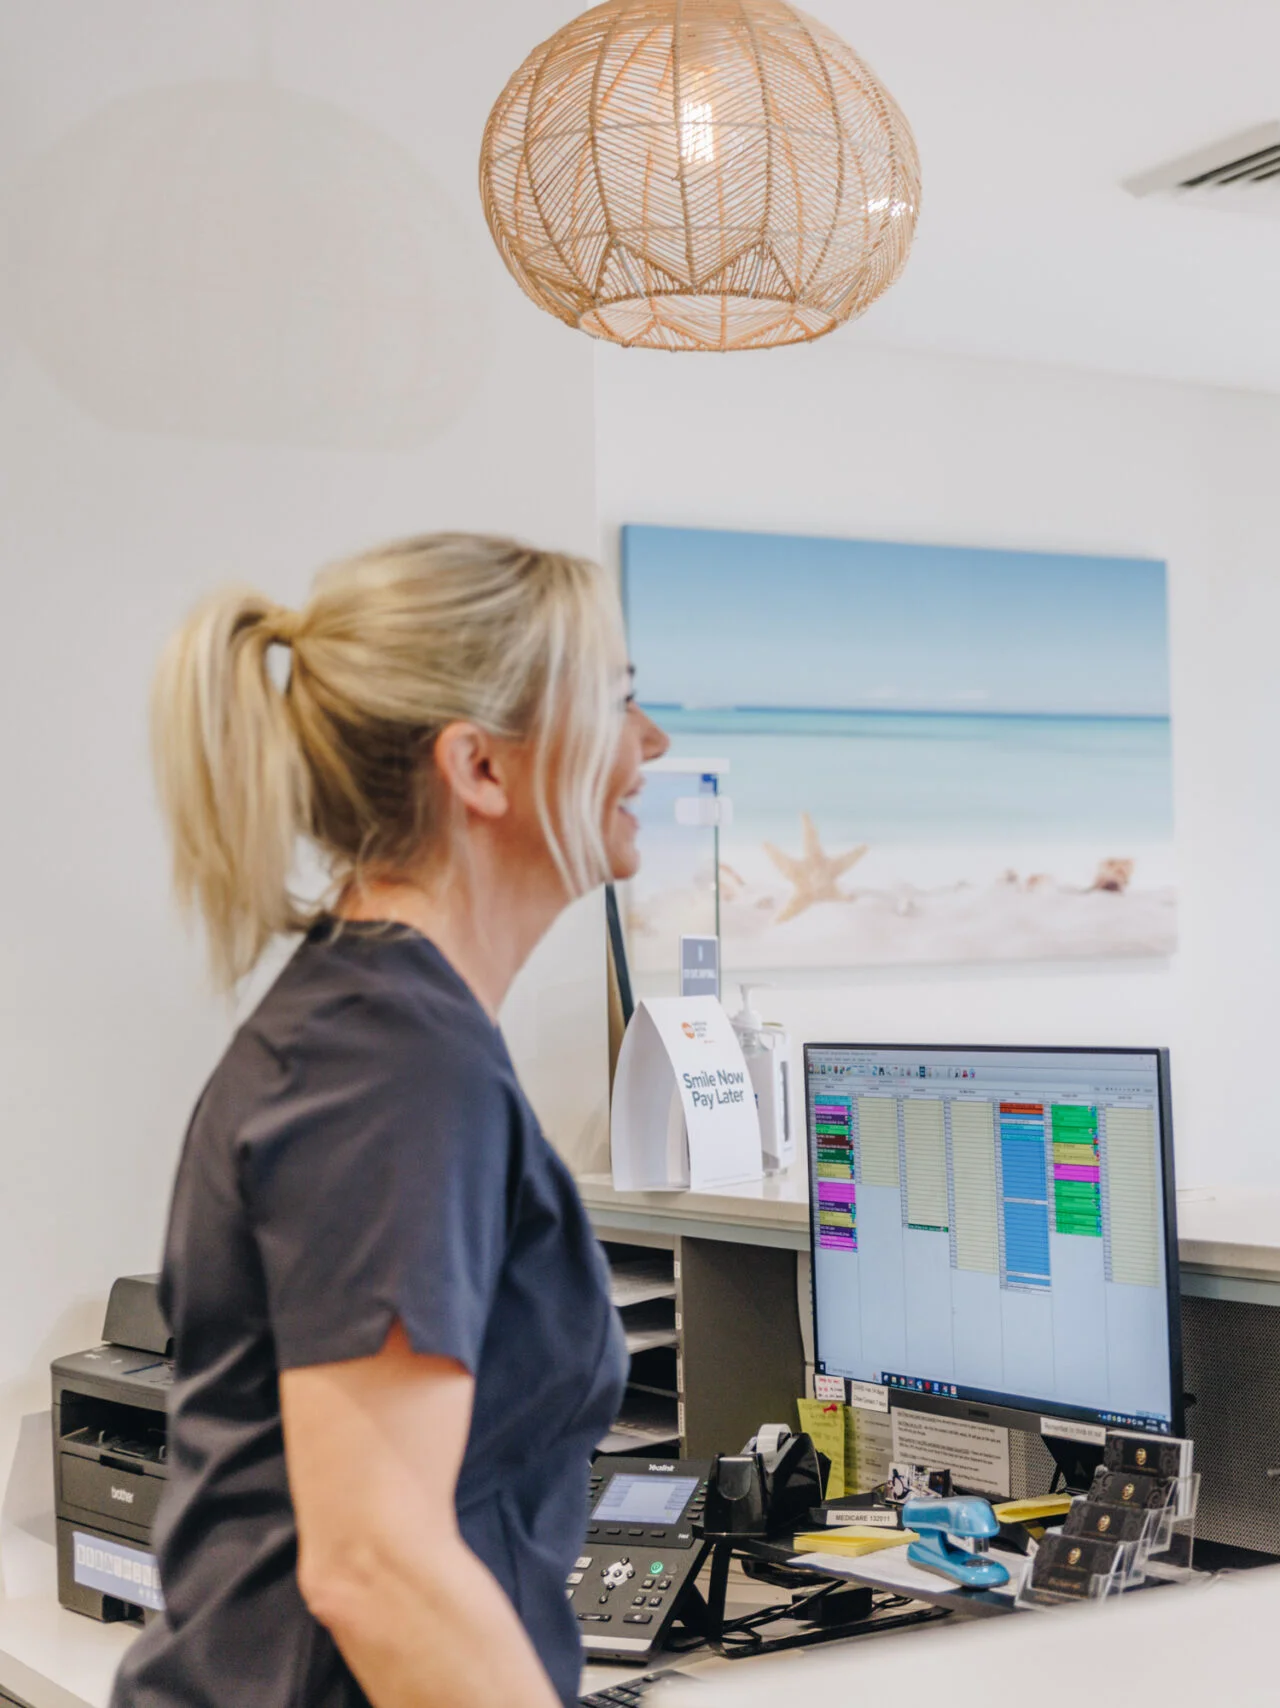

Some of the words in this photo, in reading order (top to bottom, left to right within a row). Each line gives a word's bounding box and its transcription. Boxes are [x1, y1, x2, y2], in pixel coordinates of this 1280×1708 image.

[683, 1070, 716, 1089] Smile
[716, 1069, 744, 1086] Now
[691, 1091, 714, 1110] Pay
[715, 1088, 744, 1105] Later
[648, 1463, 675, 1472] Yealink
[111, 1486, 134, 1503] brother
[835, 1514, 867, 1522] MEDICARE
